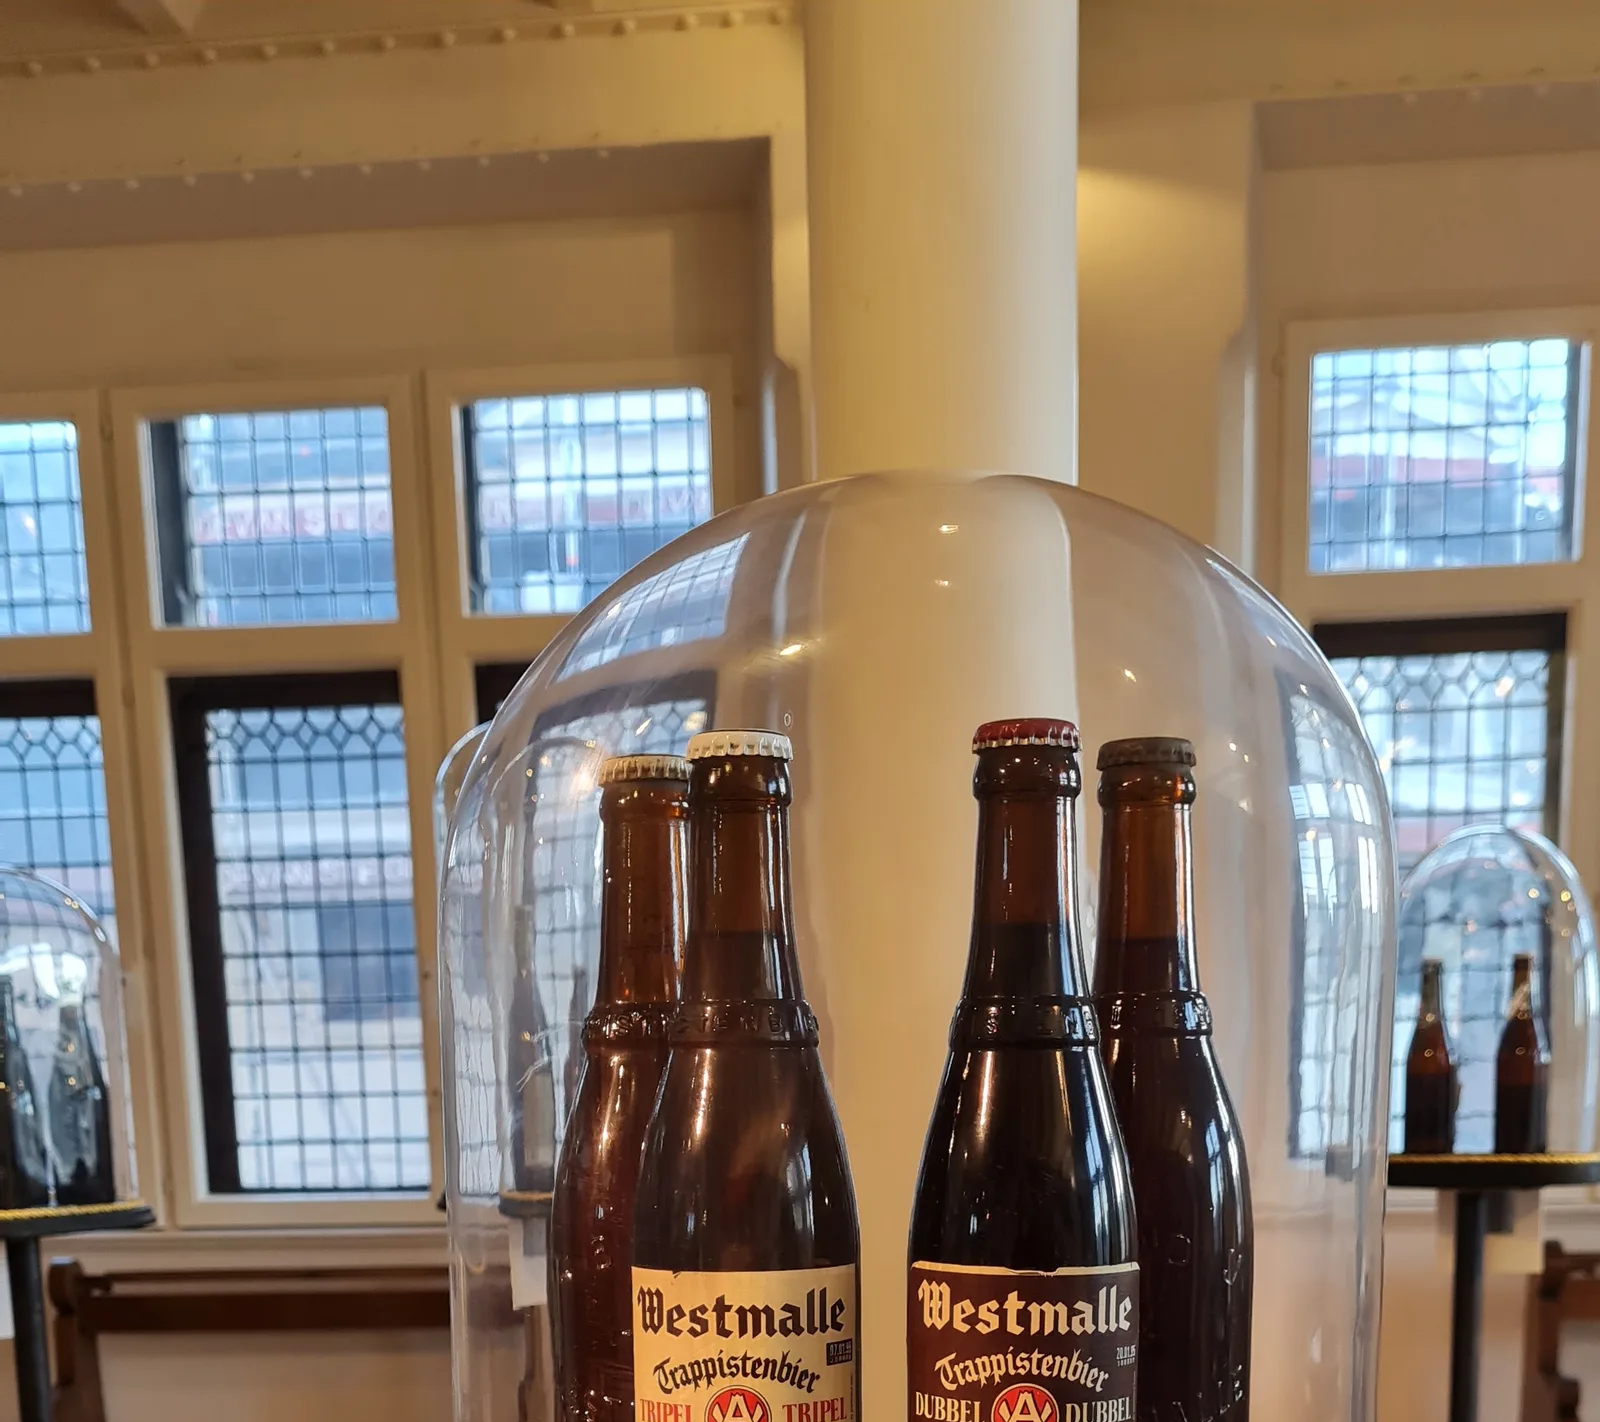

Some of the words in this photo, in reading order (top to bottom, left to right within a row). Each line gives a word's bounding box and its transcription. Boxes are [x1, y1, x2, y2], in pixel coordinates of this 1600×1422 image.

[638, 1285, 846, 1339] Westmalle
[918, 1278, 1132, 1336] Westmalle
[653, 1349, 821, 1394] Trappistenbier
[934, 1345, 1109, 1393] Trappistenbier
